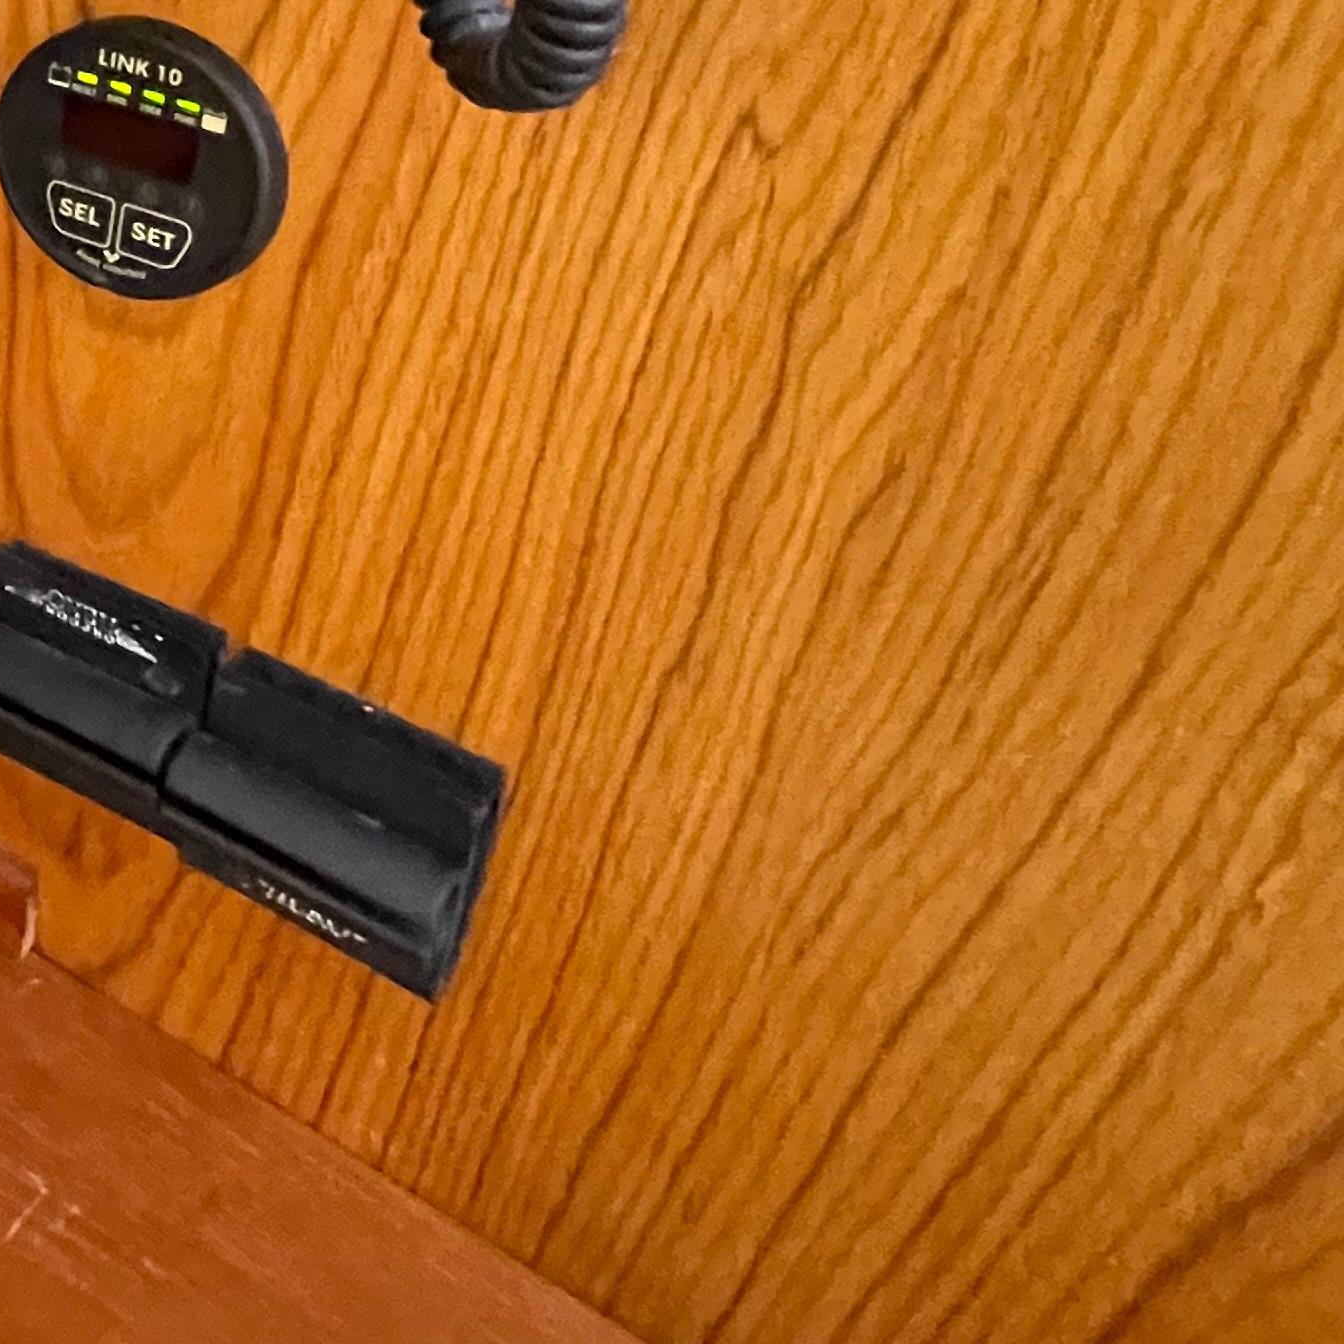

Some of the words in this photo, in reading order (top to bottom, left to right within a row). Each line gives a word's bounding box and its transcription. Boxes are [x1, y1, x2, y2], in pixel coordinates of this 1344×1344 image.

[98, 48, 149, 79] LINK
[158, 64, 184, 87] 10
[58, 197, 100, 227] SEL
[131, 221, 176, 251] SET
